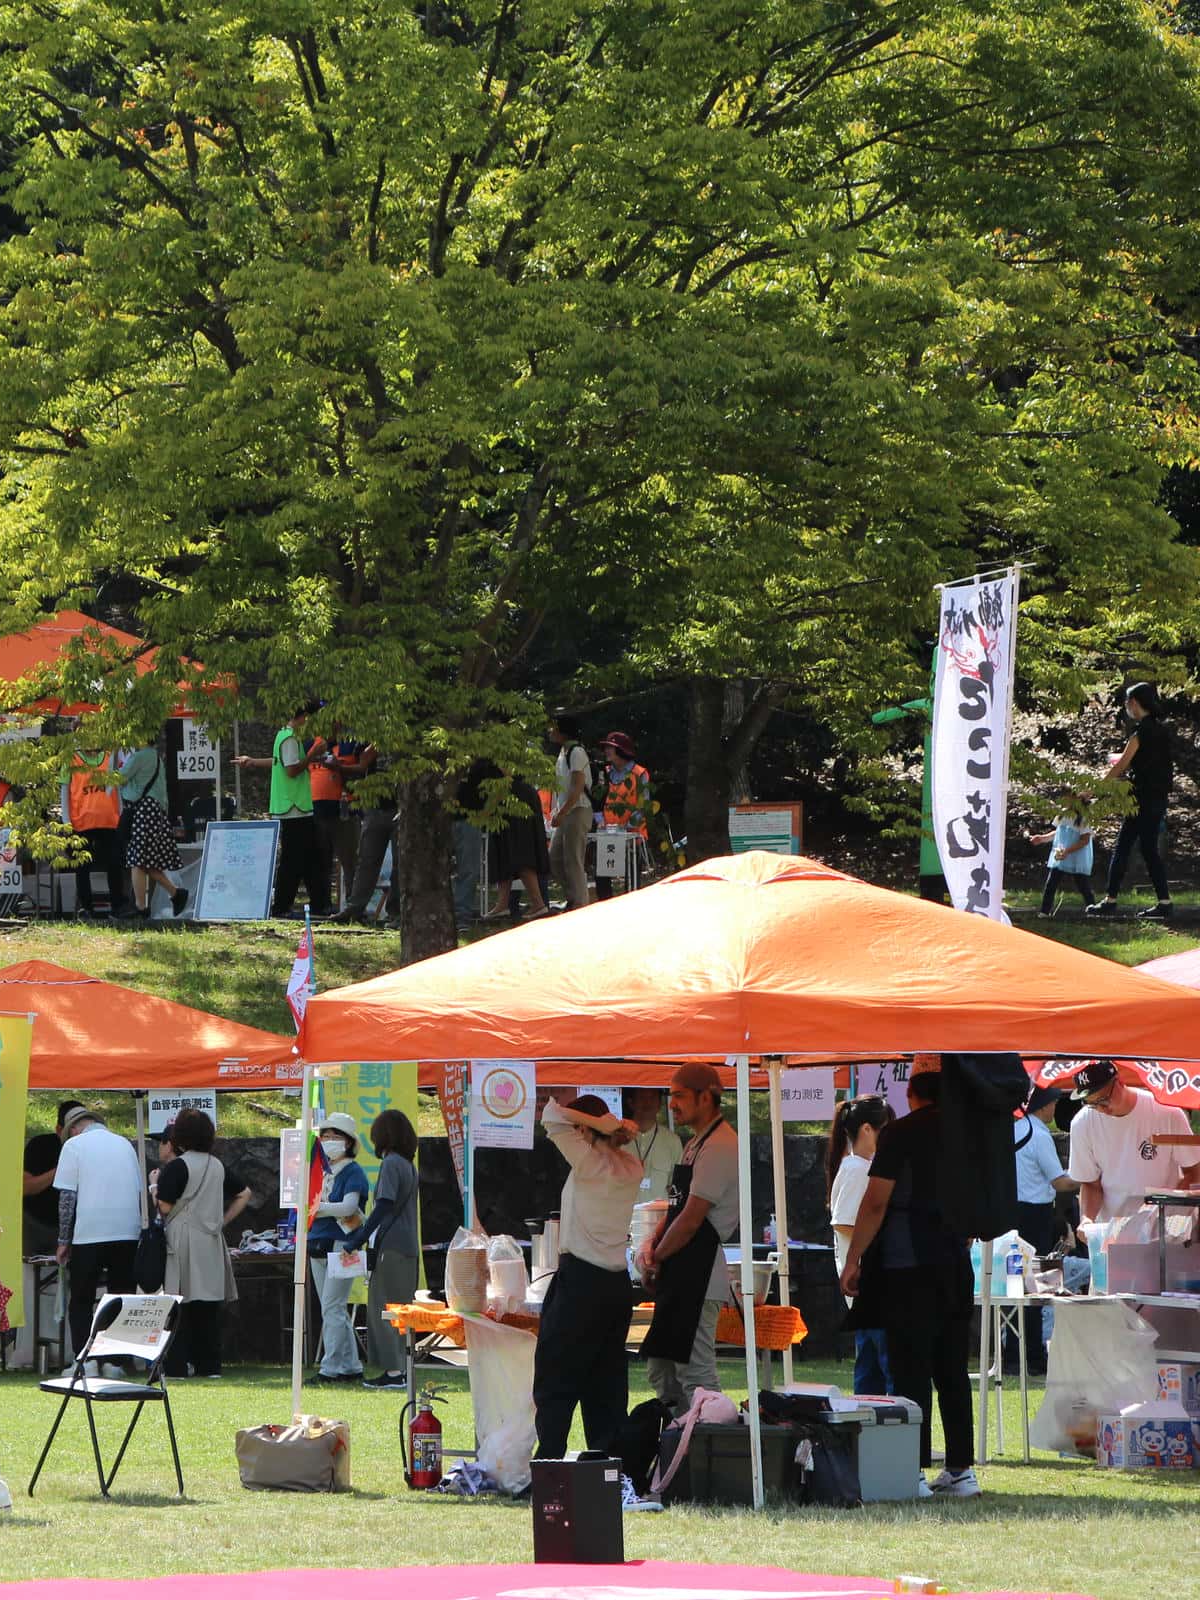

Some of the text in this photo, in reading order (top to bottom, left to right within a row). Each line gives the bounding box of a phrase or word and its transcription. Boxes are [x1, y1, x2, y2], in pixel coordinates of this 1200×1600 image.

[179, 755, 215, 772] ¥250
[606, 843, 616, 869] 受付
[781, 1087, 825, 1101] 握力測定
[151, 1097, 214, 1111] 血管年齢測定
